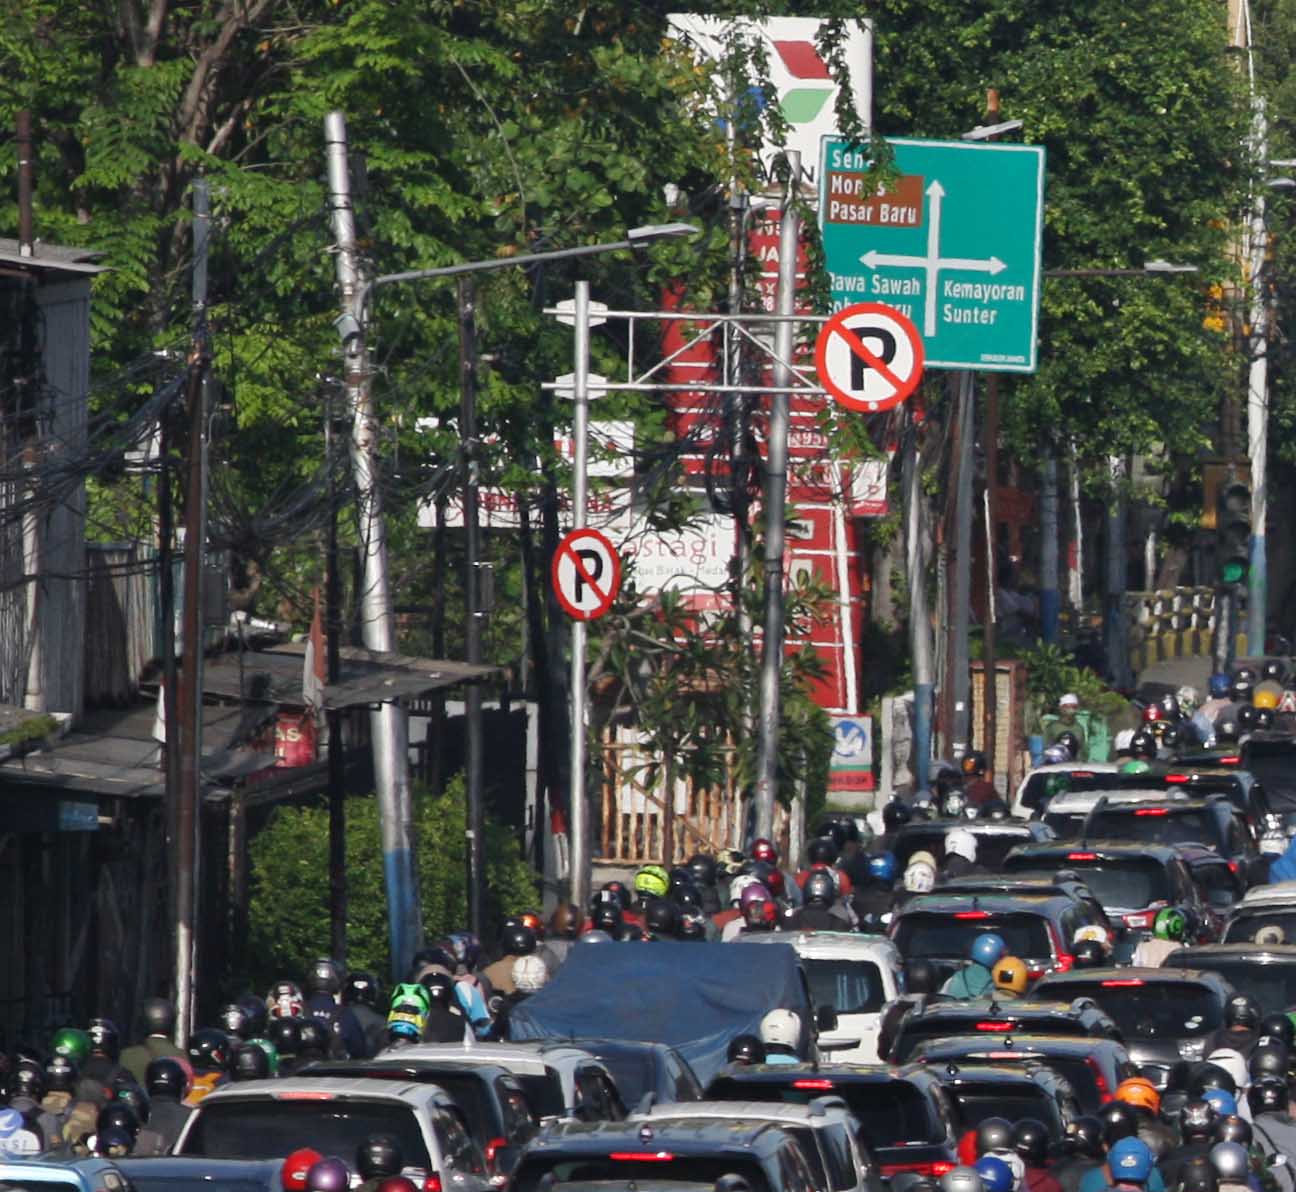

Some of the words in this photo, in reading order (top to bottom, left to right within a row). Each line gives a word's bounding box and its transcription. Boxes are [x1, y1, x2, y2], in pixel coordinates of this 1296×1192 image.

[831, 175, 886, 198] Mons
[829, 200, 873, 222] Pasar
[880, 203, 917, 224] Baru
[871, 273, 921, 296] Sawah
[943, 279, 1025, 307] Kemayoran
[943, 303, 998, 325] Sunter
